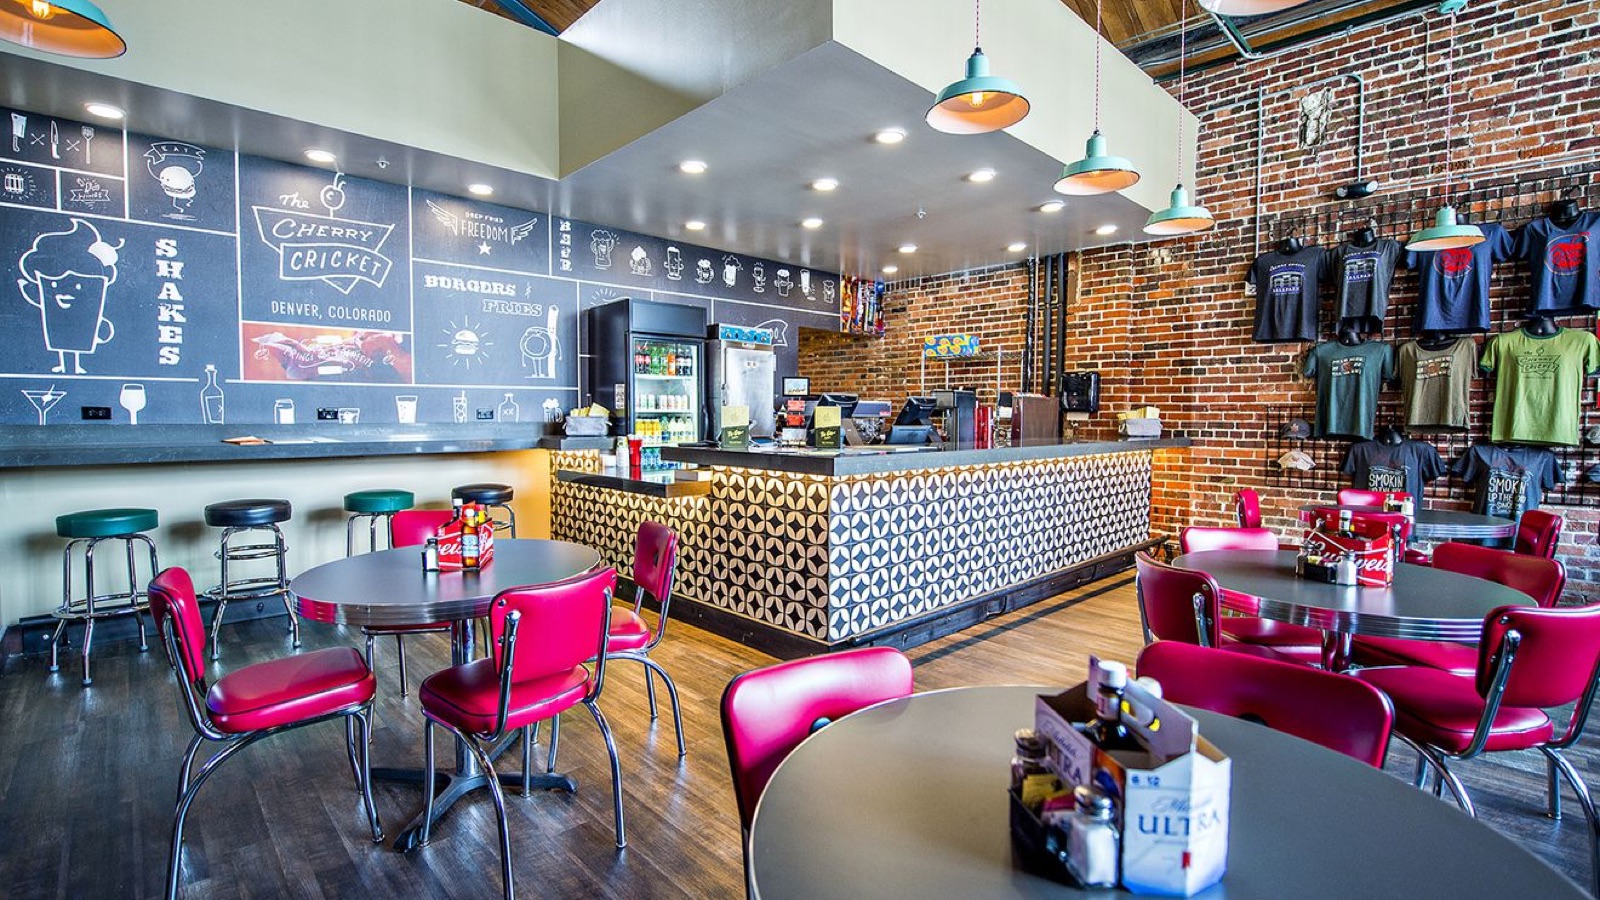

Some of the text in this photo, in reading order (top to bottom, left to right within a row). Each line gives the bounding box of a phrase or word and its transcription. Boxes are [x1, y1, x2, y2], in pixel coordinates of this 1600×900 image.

[279, 192, 310, 209] The
[272, 218, 373, 242] CHERRY
[461, 219, 508, 243] FREEDOM
[290, 250, 382, 277] CRICKET
[424, 275, 516, 297] BURGERS
[156, 239, 187, 365] SHAKES
[271, 300, 391, 323] DENVER, COLORADO
[482, 298, 543, 317] FRIES
[1138, 810, 1222, 838] ULTRA
